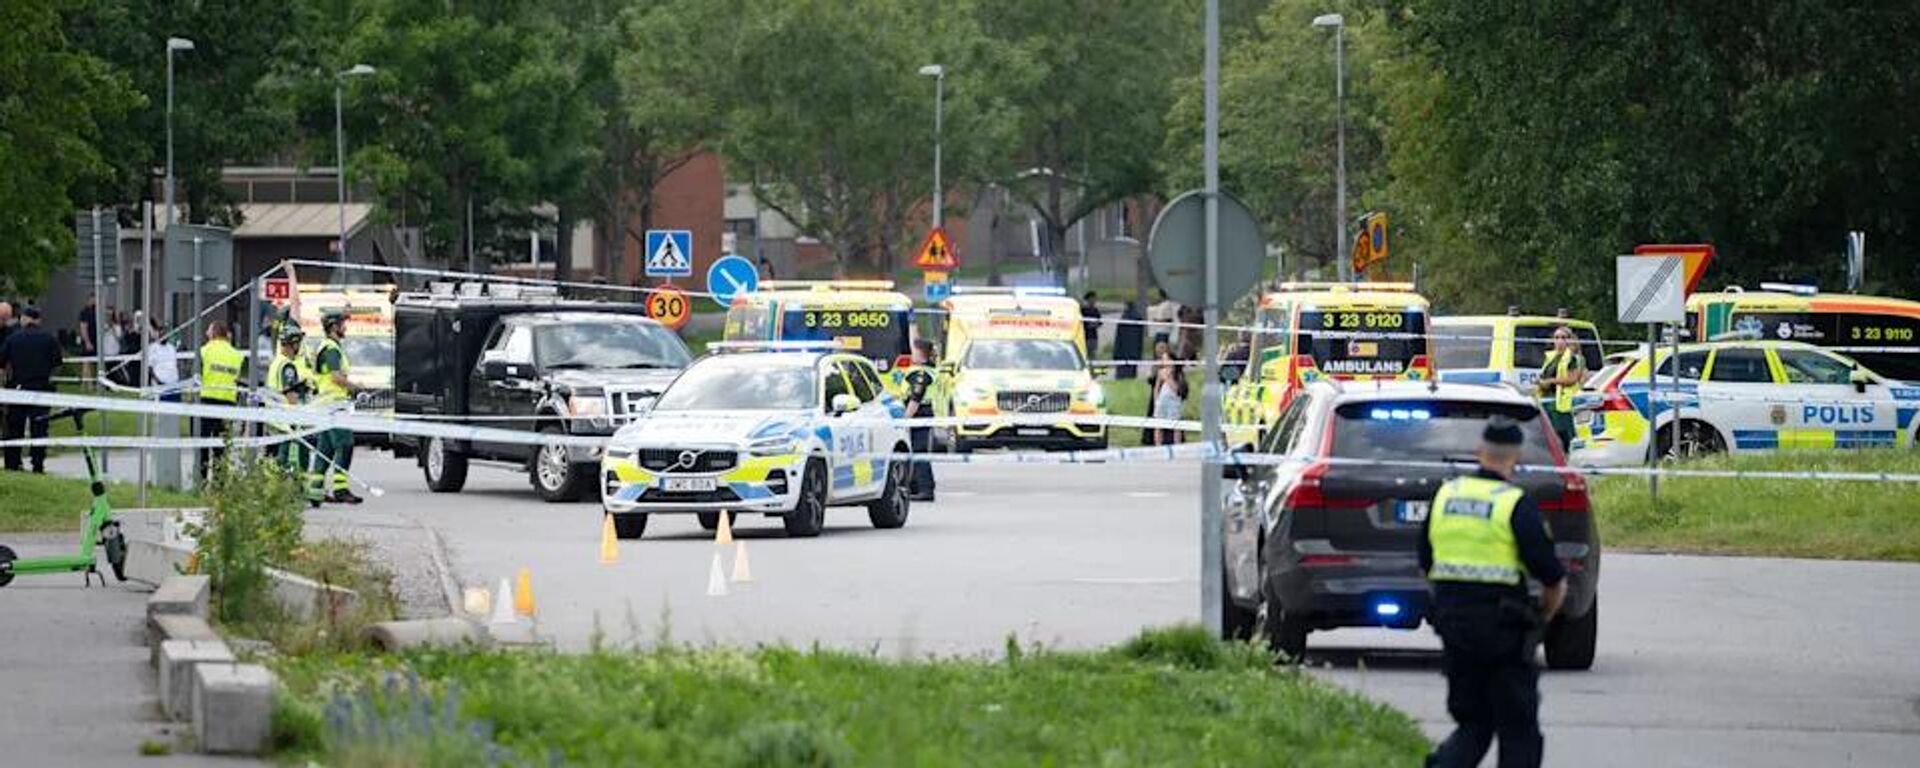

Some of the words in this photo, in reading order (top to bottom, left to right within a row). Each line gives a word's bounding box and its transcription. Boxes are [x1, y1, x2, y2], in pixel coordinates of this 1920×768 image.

[655, 297, 682, 317] 30
[805, 312, 816, 327] 3
[822, 312, 842, 327] 23
[848, 312, 889, 327] 9650
[1323, 313, 1335, 328] 3
[1340, 313, 1360, 328] 23
[1365, 313, 1402, 328] 9120
[1851, 328, 1861, 340] 3
[1865, 328, 1881, 340] 23
[1885, 328, 1913, 340] 9110
[1323, 360, 1403, 373] AMBULANS
[1803, 405, 1875, 424] POLIS
